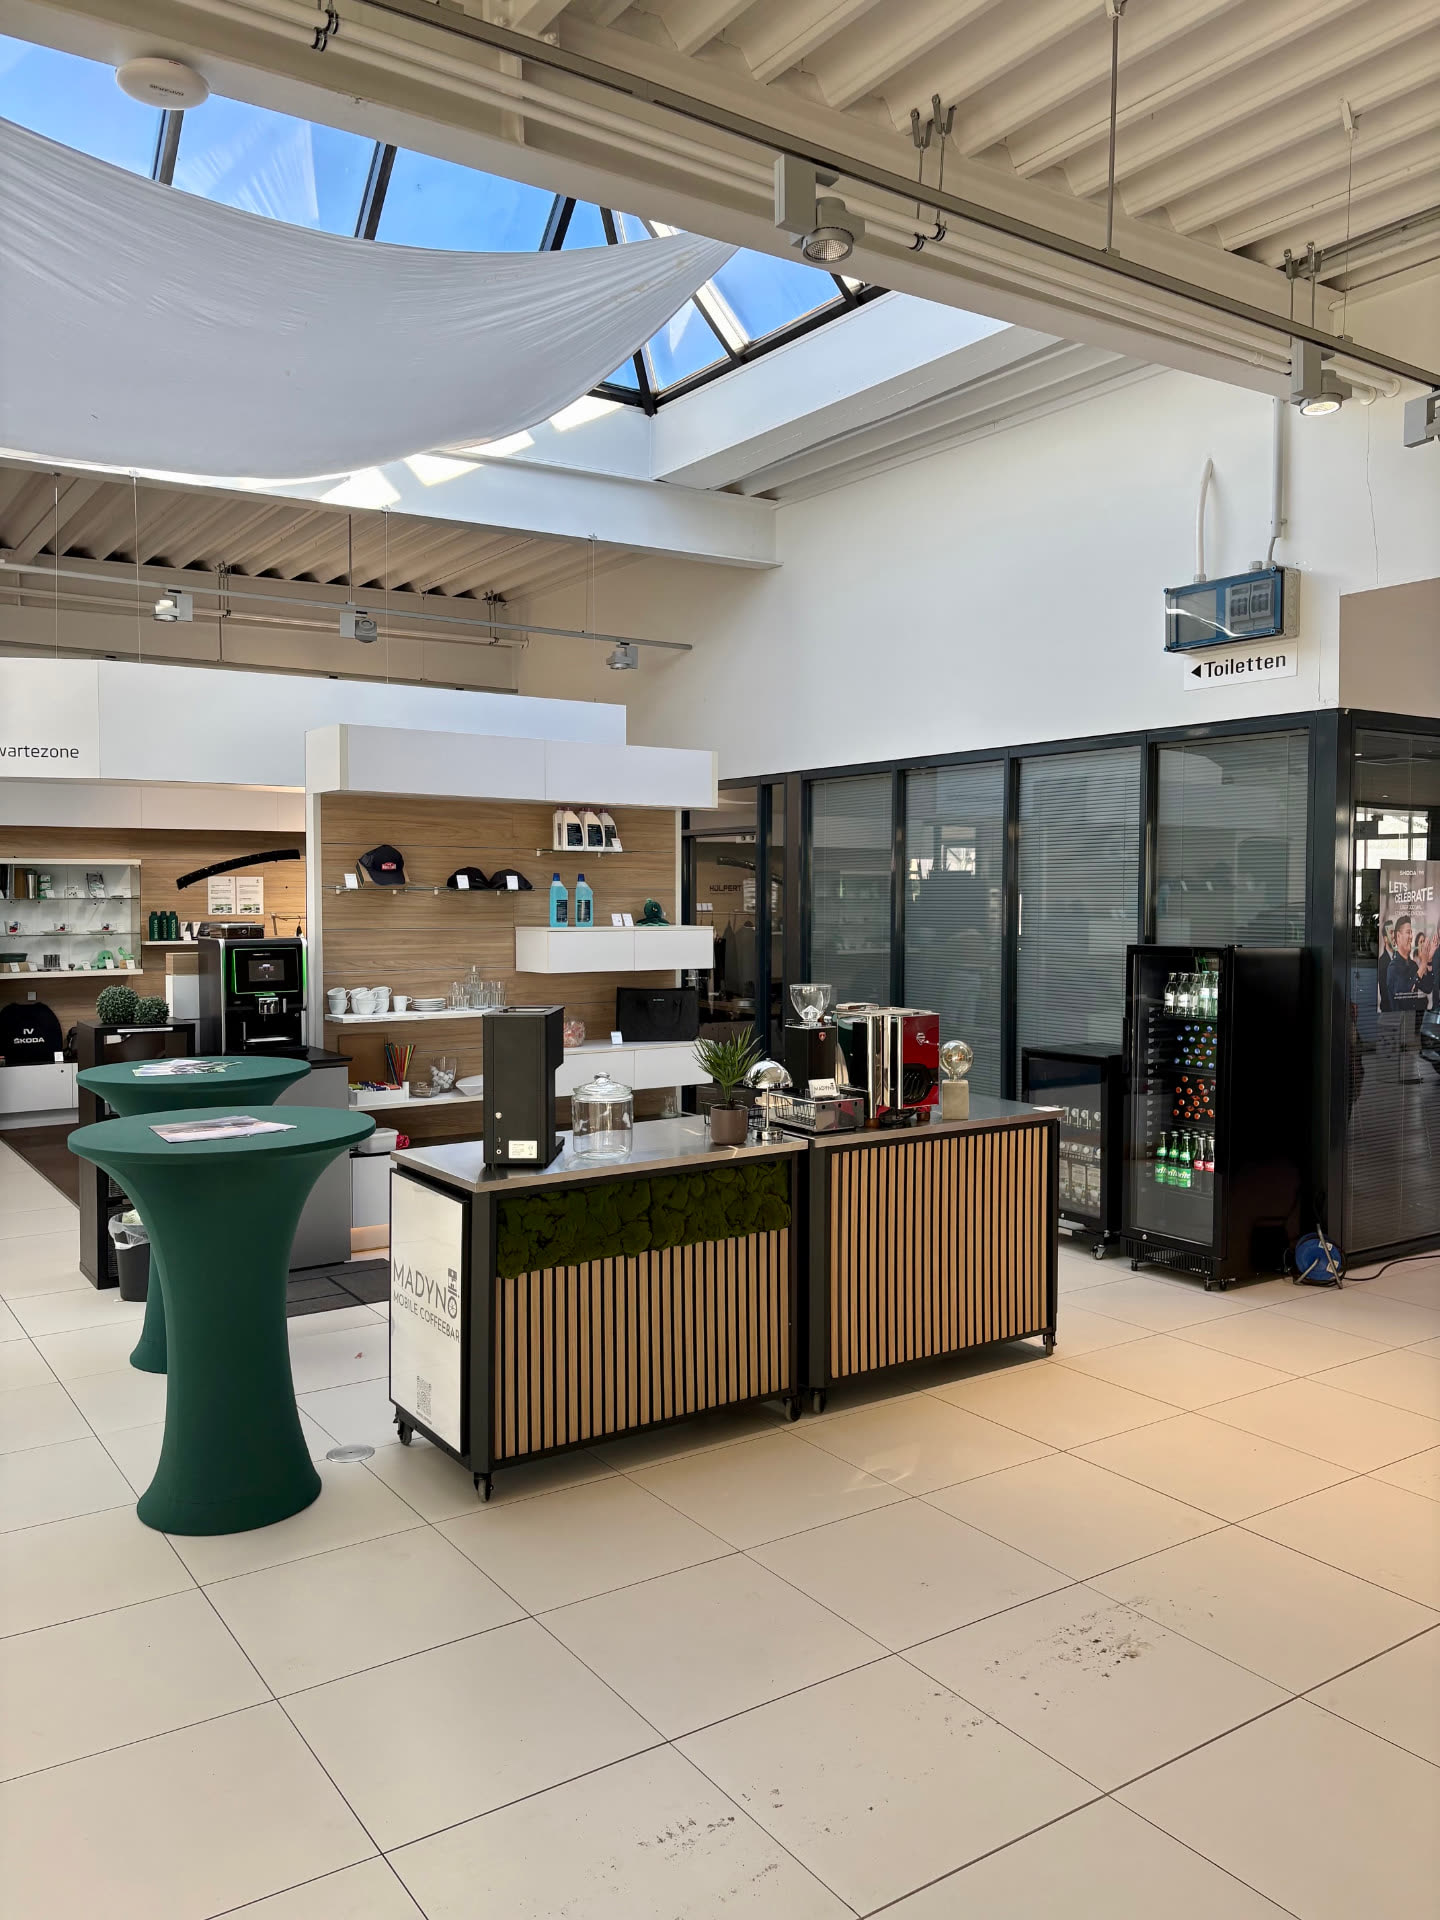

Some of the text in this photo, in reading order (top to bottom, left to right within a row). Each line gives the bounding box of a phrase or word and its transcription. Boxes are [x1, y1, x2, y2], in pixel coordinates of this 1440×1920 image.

[1203, 655, 1286, 678] Toiletten
[1389, 880, 1408, 894] LET'S
[1394, 886, 1434, 904] CELEBRATE
[393, 1257, 458, 1320] MADYNO
[393, 1289, 460, 1343] MOBILE COFFEEBAR
